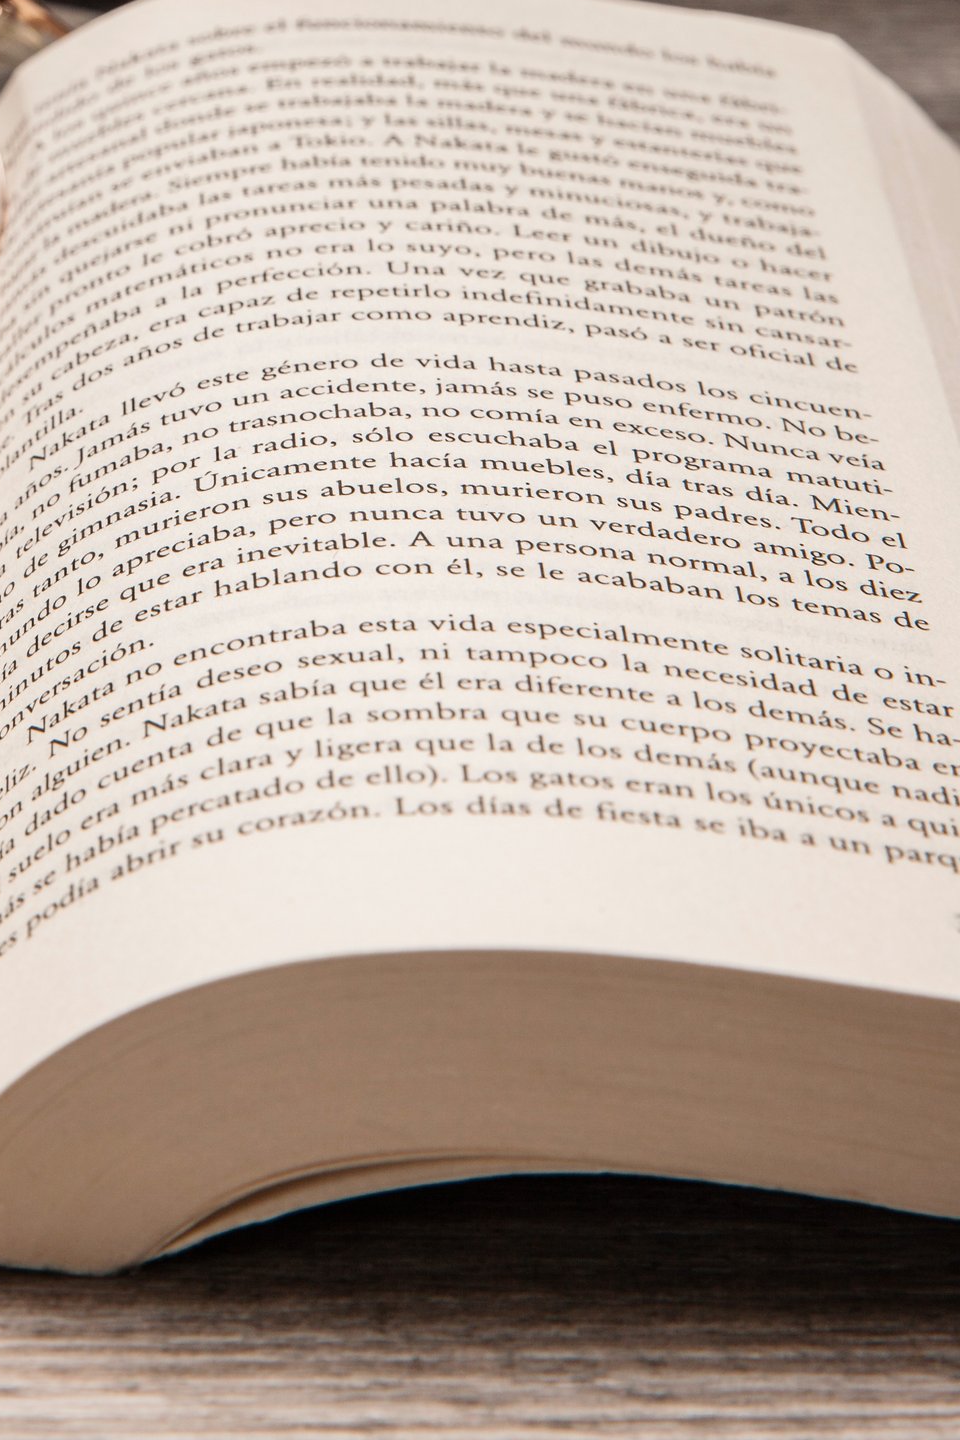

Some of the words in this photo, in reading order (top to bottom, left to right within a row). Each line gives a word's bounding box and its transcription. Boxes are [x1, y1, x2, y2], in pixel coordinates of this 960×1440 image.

[48, 264, 131, 317] pronto
[141, 252, 163, 267] le
[173, 227, 253, 257] cobró
[264, 221, 366, 239] aprecio
[377, 220, 392, 233] y
[512, 223, 570, 243] Leer
[583, 235, 619, 249] un
[630, 238, 721, 265] dibujo
[730, 257, 749, 269] o
[758, 257, 831, 283] hacer
[50, 332, 139, 381] cabeza,
[148, 313, 187, 333] era
[197, 295, 274, 318] capaz
[286, 286, 318, 303] de
[330, 283, 451, 302] repetirlo
[462, 287, 694, 325] indefinidamente
[704, 318, 744, 334] sin
[754, 326, 850, 349] cansar-
[72, 421, 151, 471] Jamás
[159, 400, 223, 427] tuvo
[232, 391, 269, 407] un
[279, 377, 426, 400] accidente,
[435, 377, 518, 397] jamás
[526, 387, 554, 400] se
[563, 391, 633, 409] puso
[641, 401, 771, 430] enfermo.
[780, 416, 827, 437] No
[833, 424, 879, 445] be-
[25, 597, 109, 658] decirse
[119, 572, 171, 603] que
[181, 557, 225, 578] era
[236, 530, 396, 565] inevitable.
[408, 530, 435, 547] A
[445, 535, 504, 550] una
[514, 538, 636, 562] persona
[646, 552, 768, 583] normal,
[778, 571, 795, 584] a
[802, 568, 849, 592] los
[858, 578, 923, 604] diez
[32, 550, 104, 599] tanto,
[114, 497, 251, 550] murieron
[261, 488, 308, 506] sus
[319, 476, 448, 498] abuelos,
[459, 481, 605, 506] murieron
[615, 496, 663, 513] sus
[672, 503, 781, 531] padres.
[789, 515, 870, 544] Todo
[880, 531, 908, 550] el
[48, 725, 88, 759] No
[99, 683, 182, 728] sentía
[195, 660, 283, 689] deseo
[297, 642, 405, 669] sexual,
[419, 642, 450, 660] ni
[465, 646, 608, 669] tampoco
[621, 652, 649, 674] la
[663, 664, 818, 697] necesidad
[831, 682, 868, 705] de
[881, 696, 954, 718] estar
[8, 828, 71, 883] suelo
[79, 801, 120, 831] era
[131, 773, 189, 807] más
[199, 753, 273, 781] clara
[285, 747, 303, 767] y
[314, 738, 402, 761] ligera
[414, 738, 474, 757] que
[487, 731, 514, 752] la
[526, 733, 564, 754] de
[575, 736, 623, 759] los
[633, 742, 737, 773] demás
[746, 758, 879, 795] (aunque
